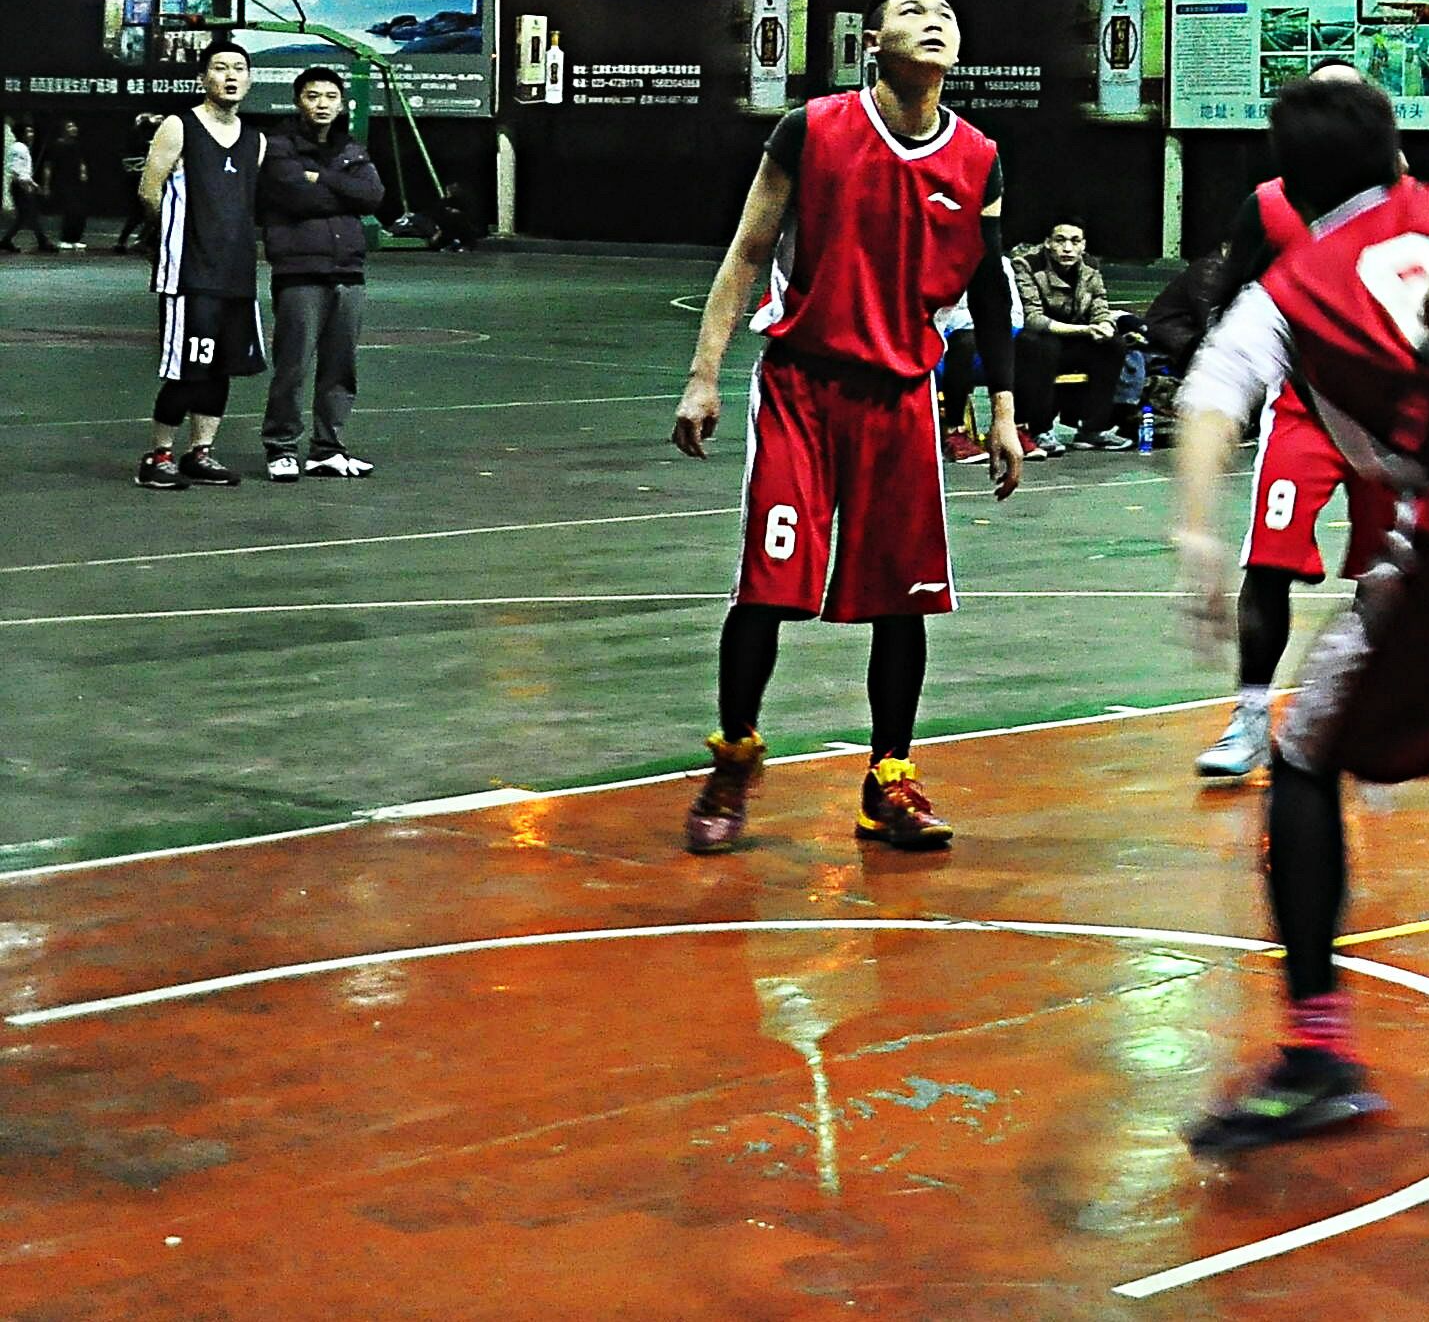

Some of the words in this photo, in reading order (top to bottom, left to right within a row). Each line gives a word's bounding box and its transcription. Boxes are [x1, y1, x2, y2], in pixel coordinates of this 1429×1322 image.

[188, 336, 216, 365] 13
[1264, 477, 1297, 531] 8
[764, 503, 799, 561] 6
